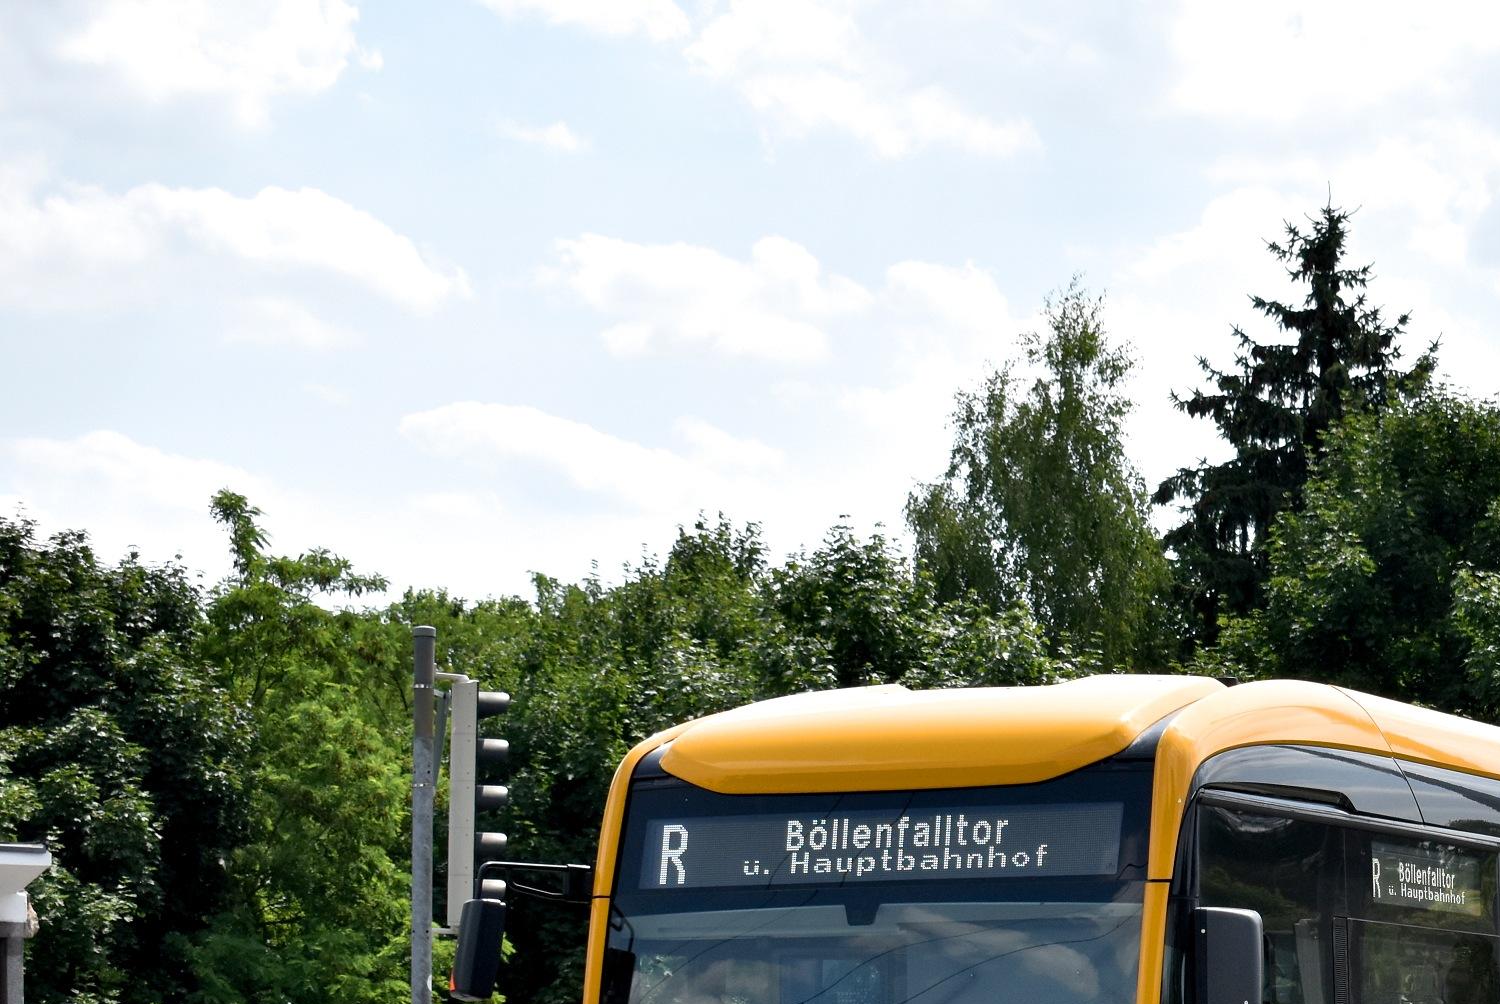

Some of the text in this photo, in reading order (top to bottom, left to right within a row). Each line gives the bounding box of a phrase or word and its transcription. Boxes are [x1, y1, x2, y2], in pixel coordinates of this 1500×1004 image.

[786, 815, 1009, 851] Böllenfalltor
[659, 825, 688, 885] R
[743, 845, 1048, 876] ü. Hauptbahnhof
[1372, 857, 1381, 898] R
[1398, 862, 1456, 889] Böllenfalltor
[1400, 883, 1465, 904] Hauptbahnhof
